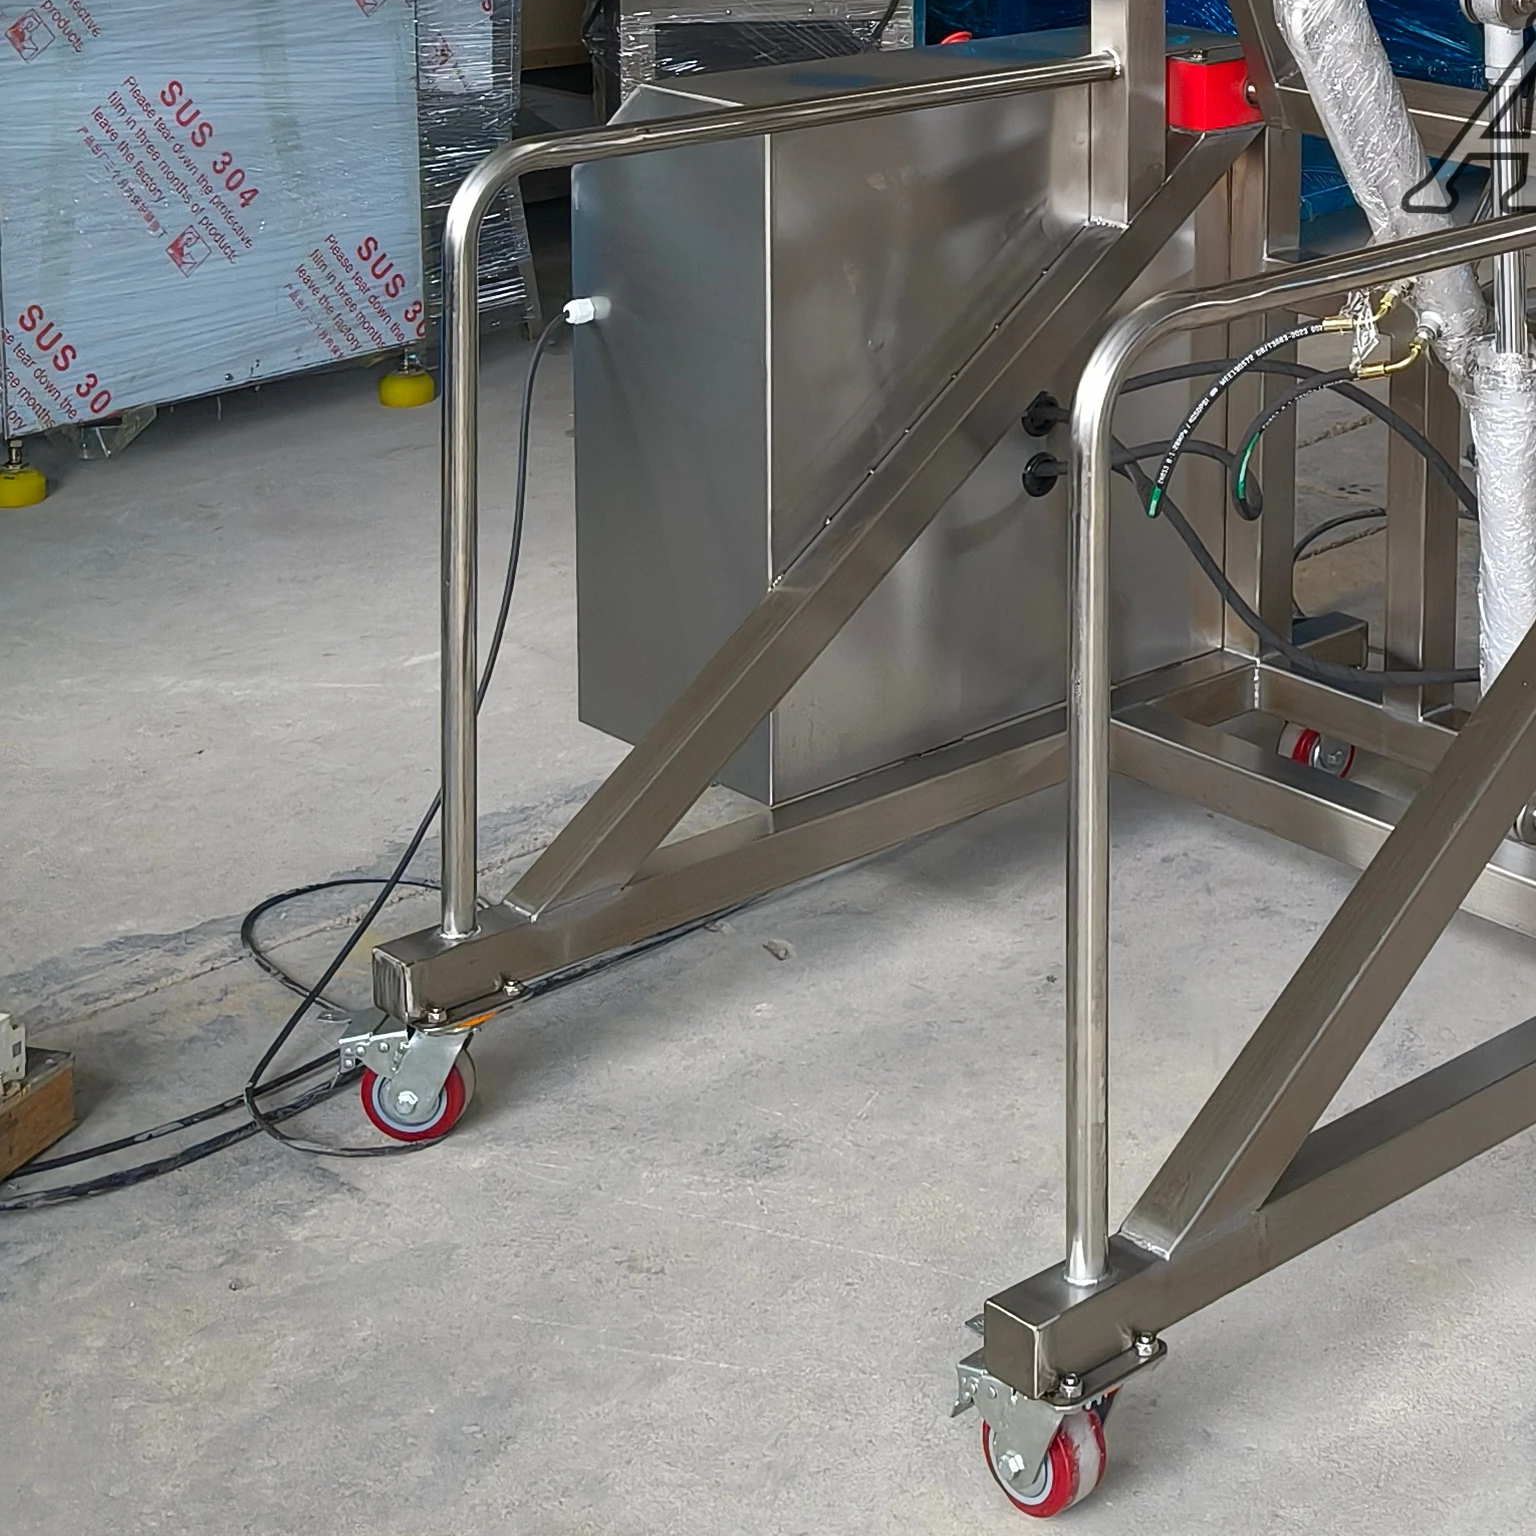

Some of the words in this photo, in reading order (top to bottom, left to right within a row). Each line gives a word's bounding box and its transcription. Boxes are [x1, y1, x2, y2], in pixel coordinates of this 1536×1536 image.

[91, 105, 119, 141] leave
[118, 140, 135, 163] the
[133, 160, 166, 202] factory
[107, 91, 127, 116] film
[125, 116, 137, 130] in
[135, 128, 160, 161] three
[159, 160, 192, 204] months
[191, 203, 205, 216] of
[198, 215, 237, 264] products
[124, 75, 156, 119] Please
[155, 116, 175, 142] tear
[173, 142, 198, 176] down
[197, 172, 213, 195] the
[210, 195, 253, 249] protective
[160, 80, 213, 148] SUS
[212, 152, 259, 208] 304
[295, 263, 320, 296] leave
[319, 294, 334, 314] the
[332, 313, 362, 351] factory
[309, 249, 327, 272] film
[326, 271, 336, 284] in
[334, 281, 358, 313] three
[355, 312, 386, 349] months
[325, 233, 354, 273] Please
[352, 271, 372, 294] tear
[368, 294, 392, 325] down
[390, 322, 405, 342] the
[357, 236, 405, 298] SUS
[13, 342, 36, 368] tear
[33, 368, 61, 401] down
[60, 397, 77, 419] the
[19, 305, 77, 371] SUS
[76, 373, 111, 414] 30
